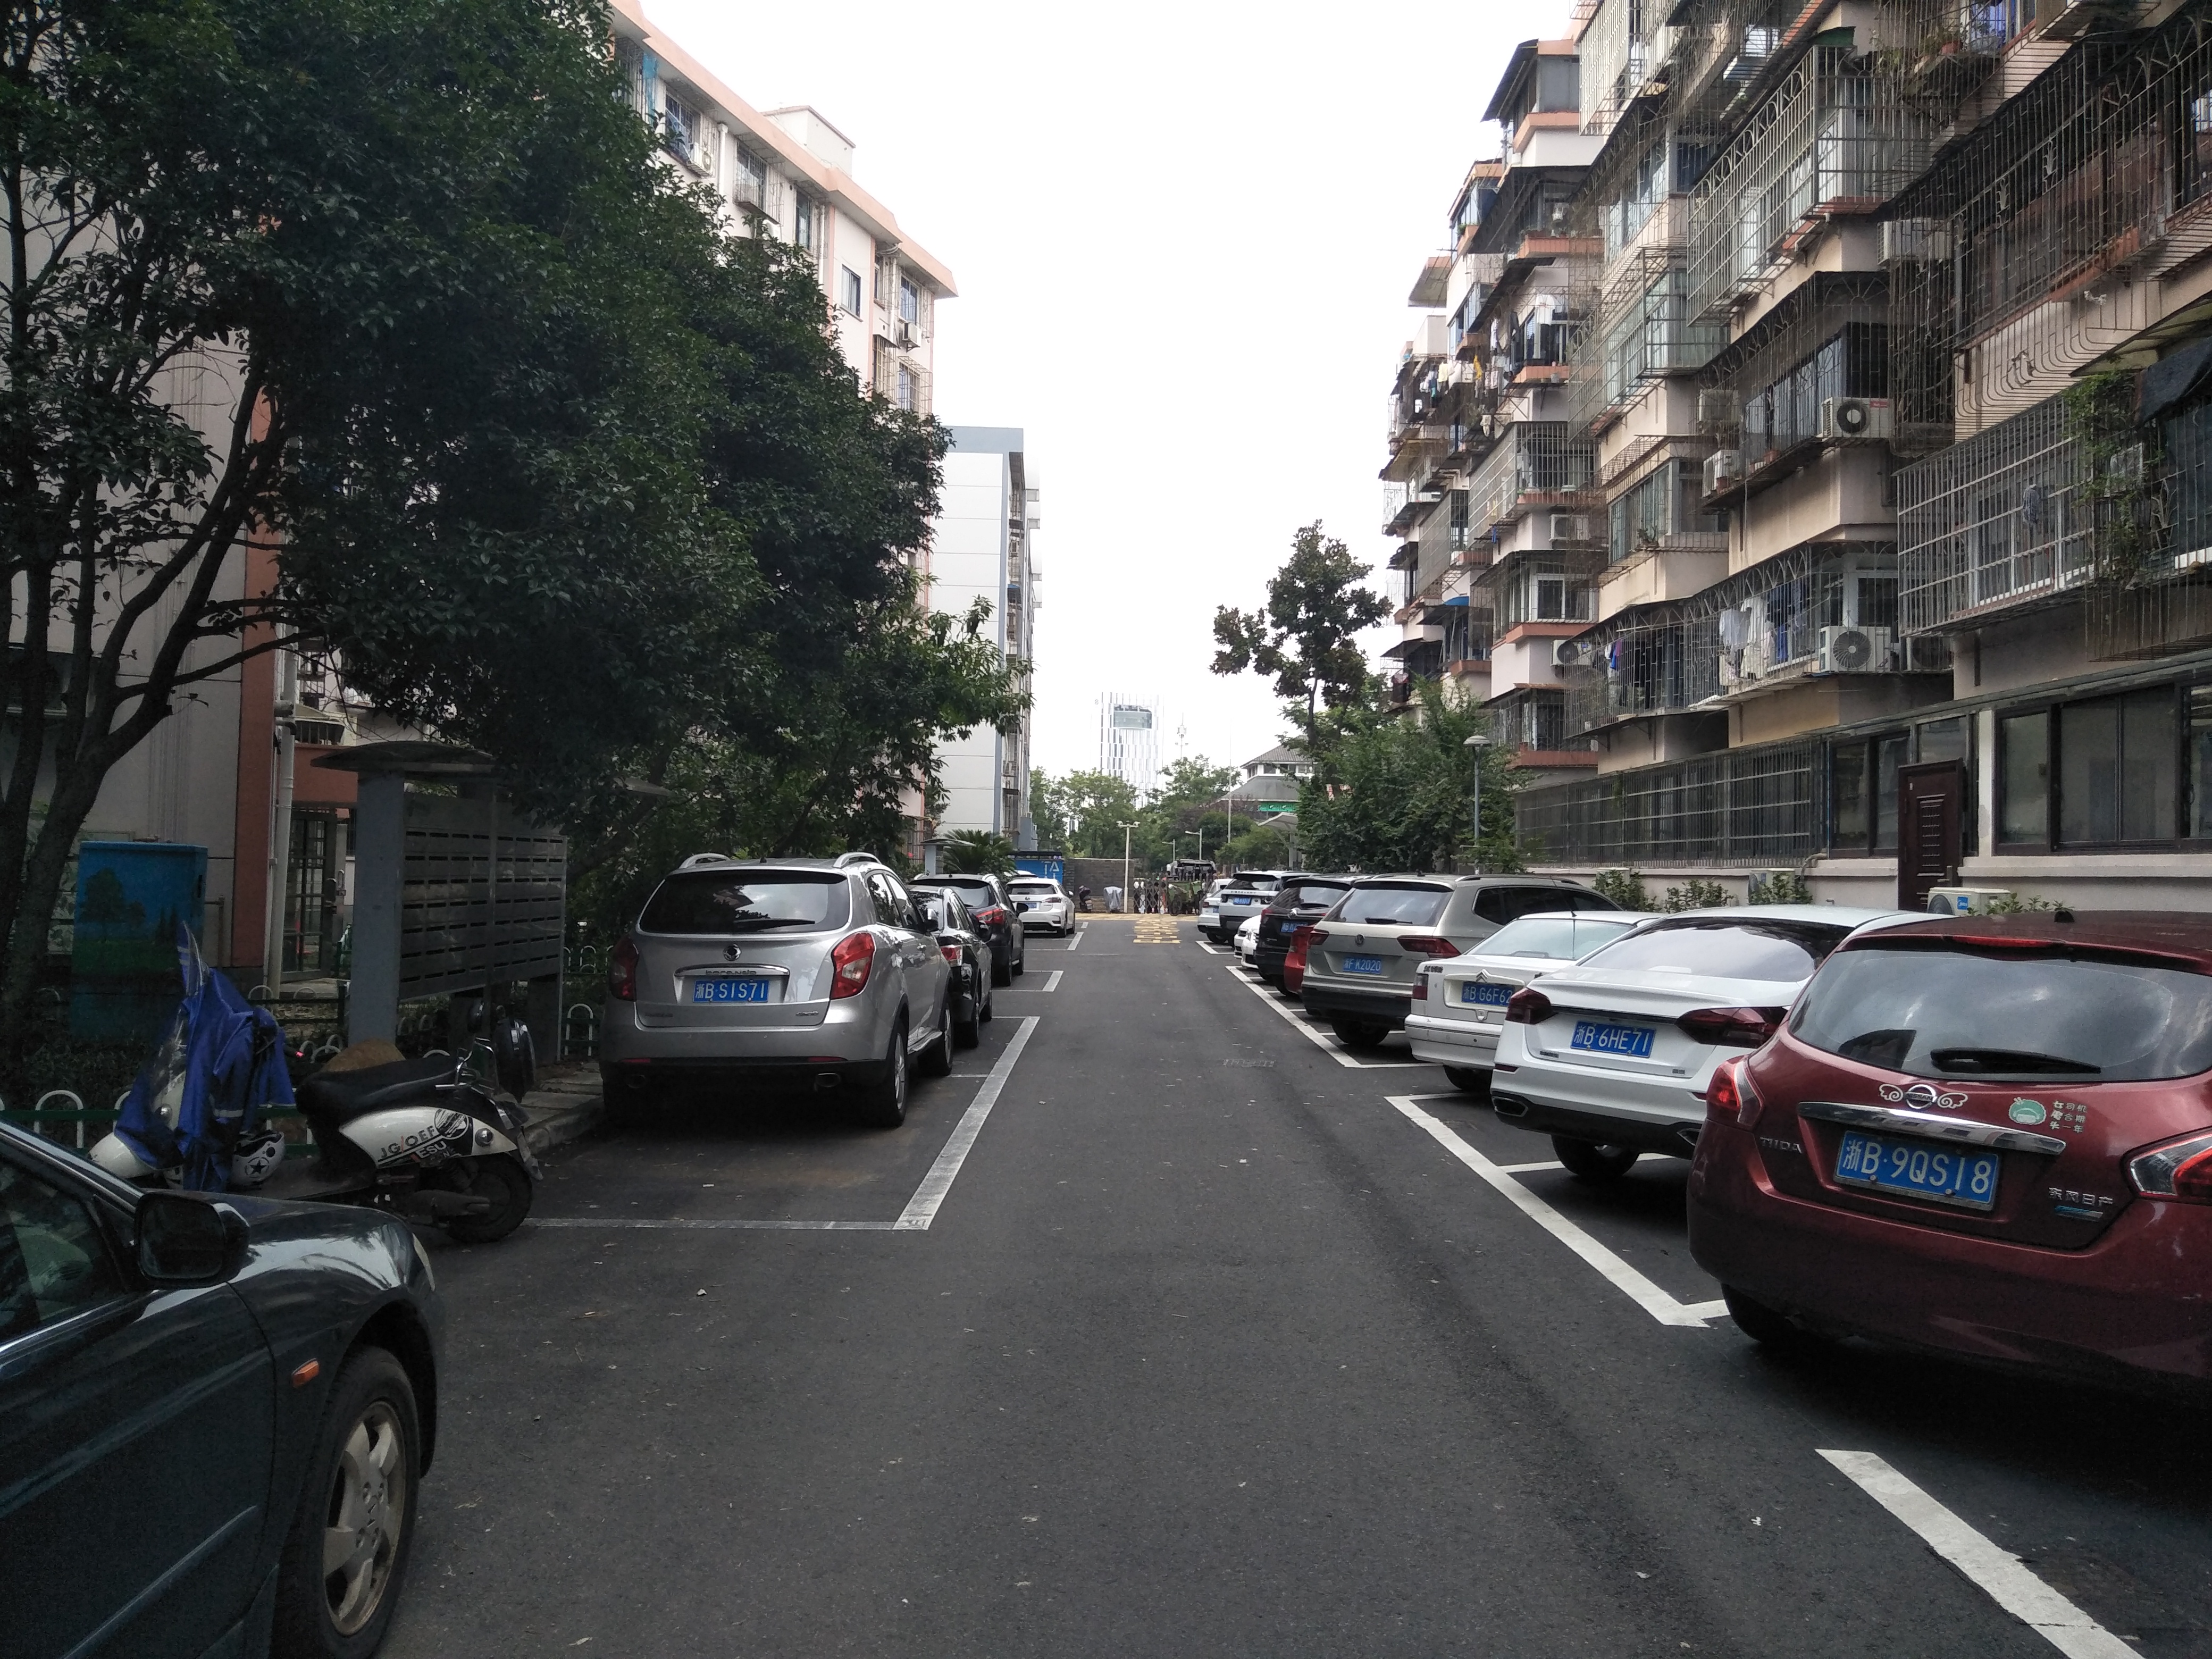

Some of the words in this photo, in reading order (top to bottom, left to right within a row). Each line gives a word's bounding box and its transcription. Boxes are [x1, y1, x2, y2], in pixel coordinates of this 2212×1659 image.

[2053, 1100, 2087, 1112] 女司机
[2050, 1121, 2083, 1133] 头一年
[2049, 1187, 2113, 1207] 东风日产
